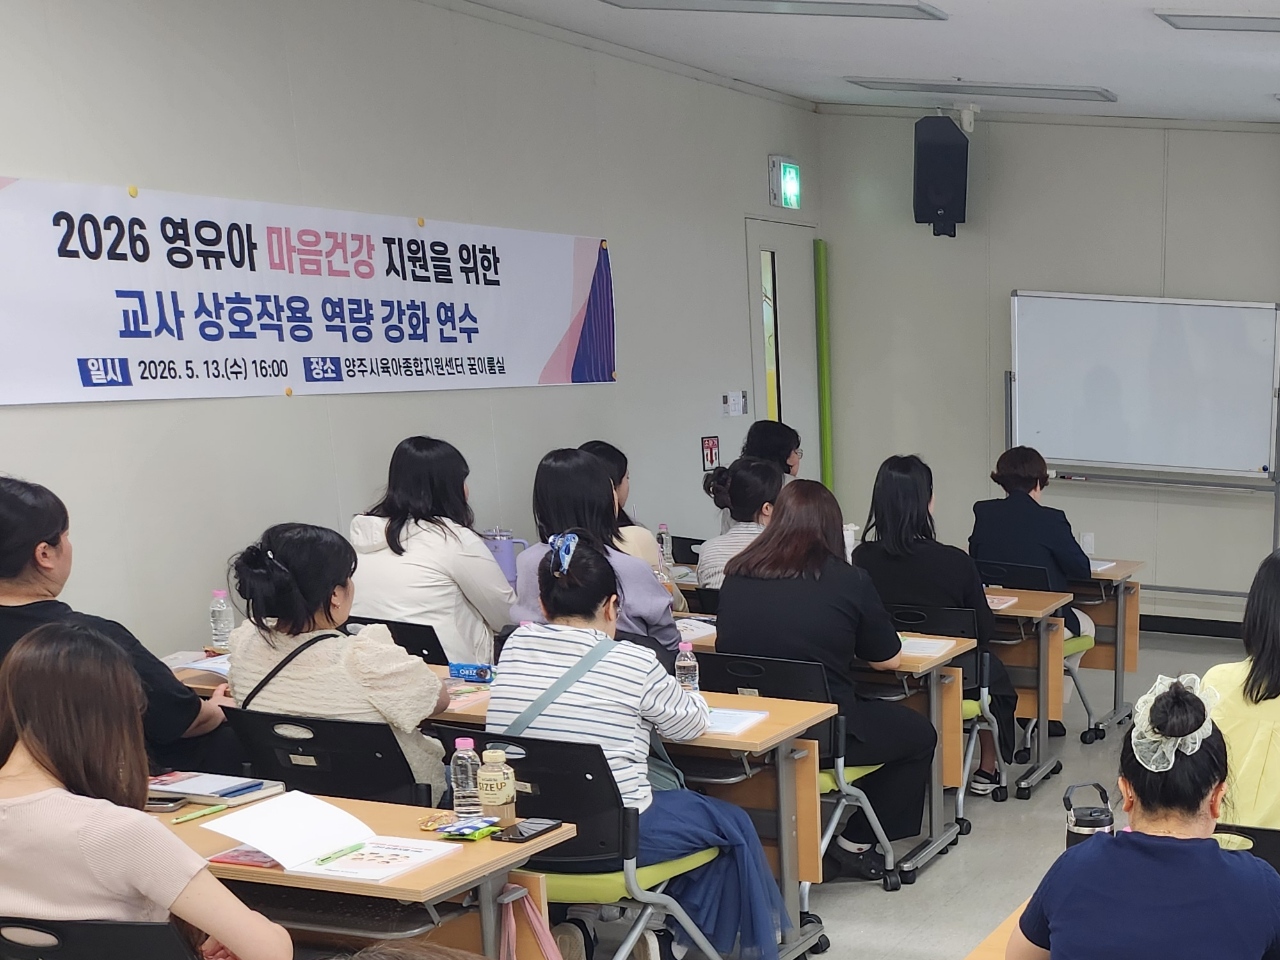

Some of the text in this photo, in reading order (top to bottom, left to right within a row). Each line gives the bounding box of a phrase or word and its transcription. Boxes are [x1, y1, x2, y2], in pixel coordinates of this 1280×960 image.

[52, 210, 501, 287] 2026 영유아 마음건강 지원을 위한
[114, 289, 480, 344] 교사 상호작용 역량 강화 연수
[87, 358, 123, 384] 일시
[138, 360, 182, 380] 2026.
[185, 360, 200, 380] 5.
[251, 358, 289, 378] 16:00
[309, 356, 507, 379] 장소 양주시육아종합지원센터 꿈이룸실
